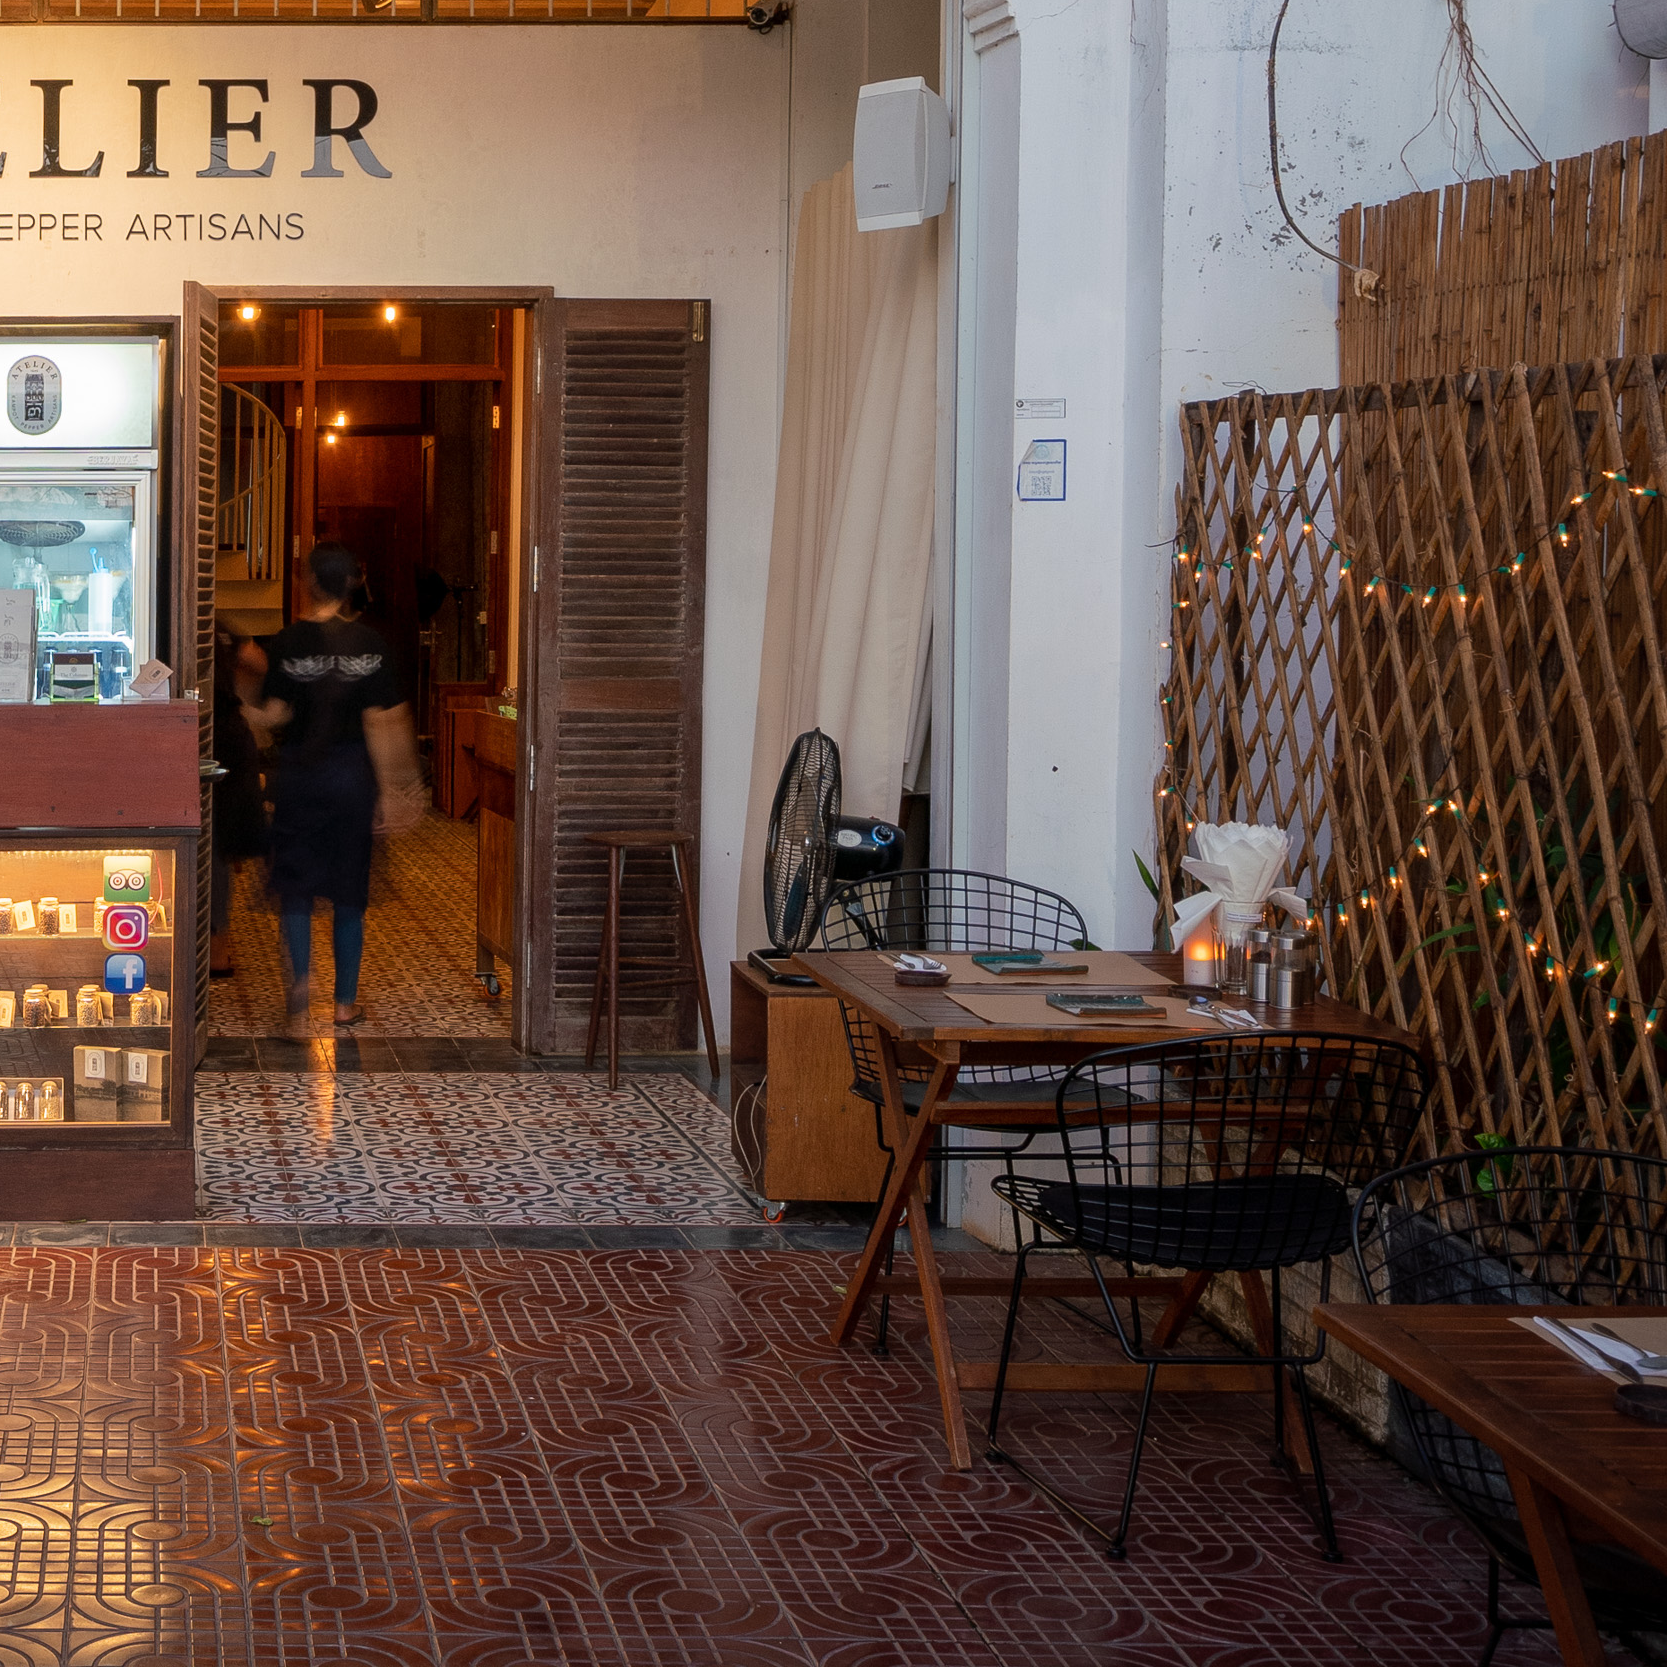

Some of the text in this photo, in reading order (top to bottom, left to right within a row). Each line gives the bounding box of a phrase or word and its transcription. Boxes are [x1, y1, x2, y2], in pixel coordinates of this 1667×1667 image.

[125, 212, 306, 242] ARTISANS
[12, 360, 58, 380] ATELIER
[11, 394, 58, 430] KAMPOT PEPPER ARTISANS
